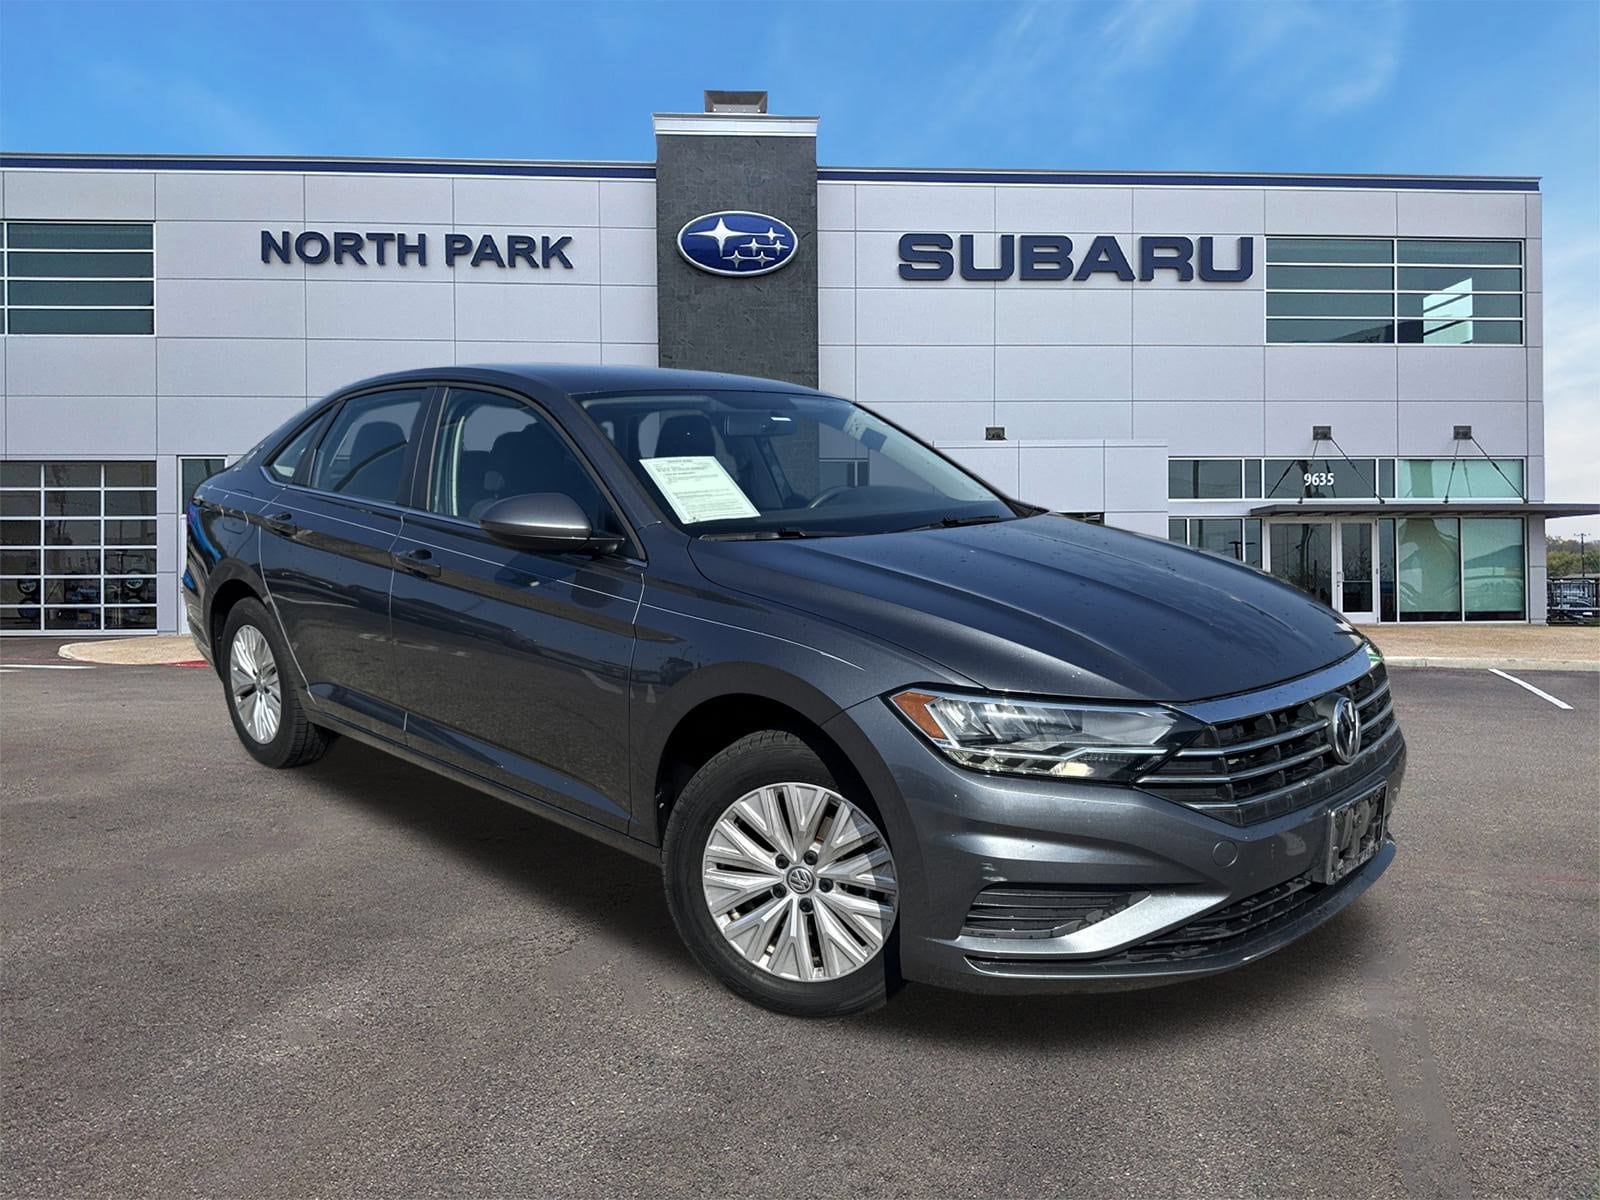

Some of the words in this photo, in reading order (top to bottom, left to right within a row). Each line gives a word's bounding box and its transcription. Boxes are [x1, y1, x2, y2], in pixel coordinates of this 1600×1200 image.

[261, 230, 427, 267] NORTH
[444, 233, 574, 269] PARK
[898, 233, 1254, 282] SUBARU
[1303, 472, 1335, 486] 9635
